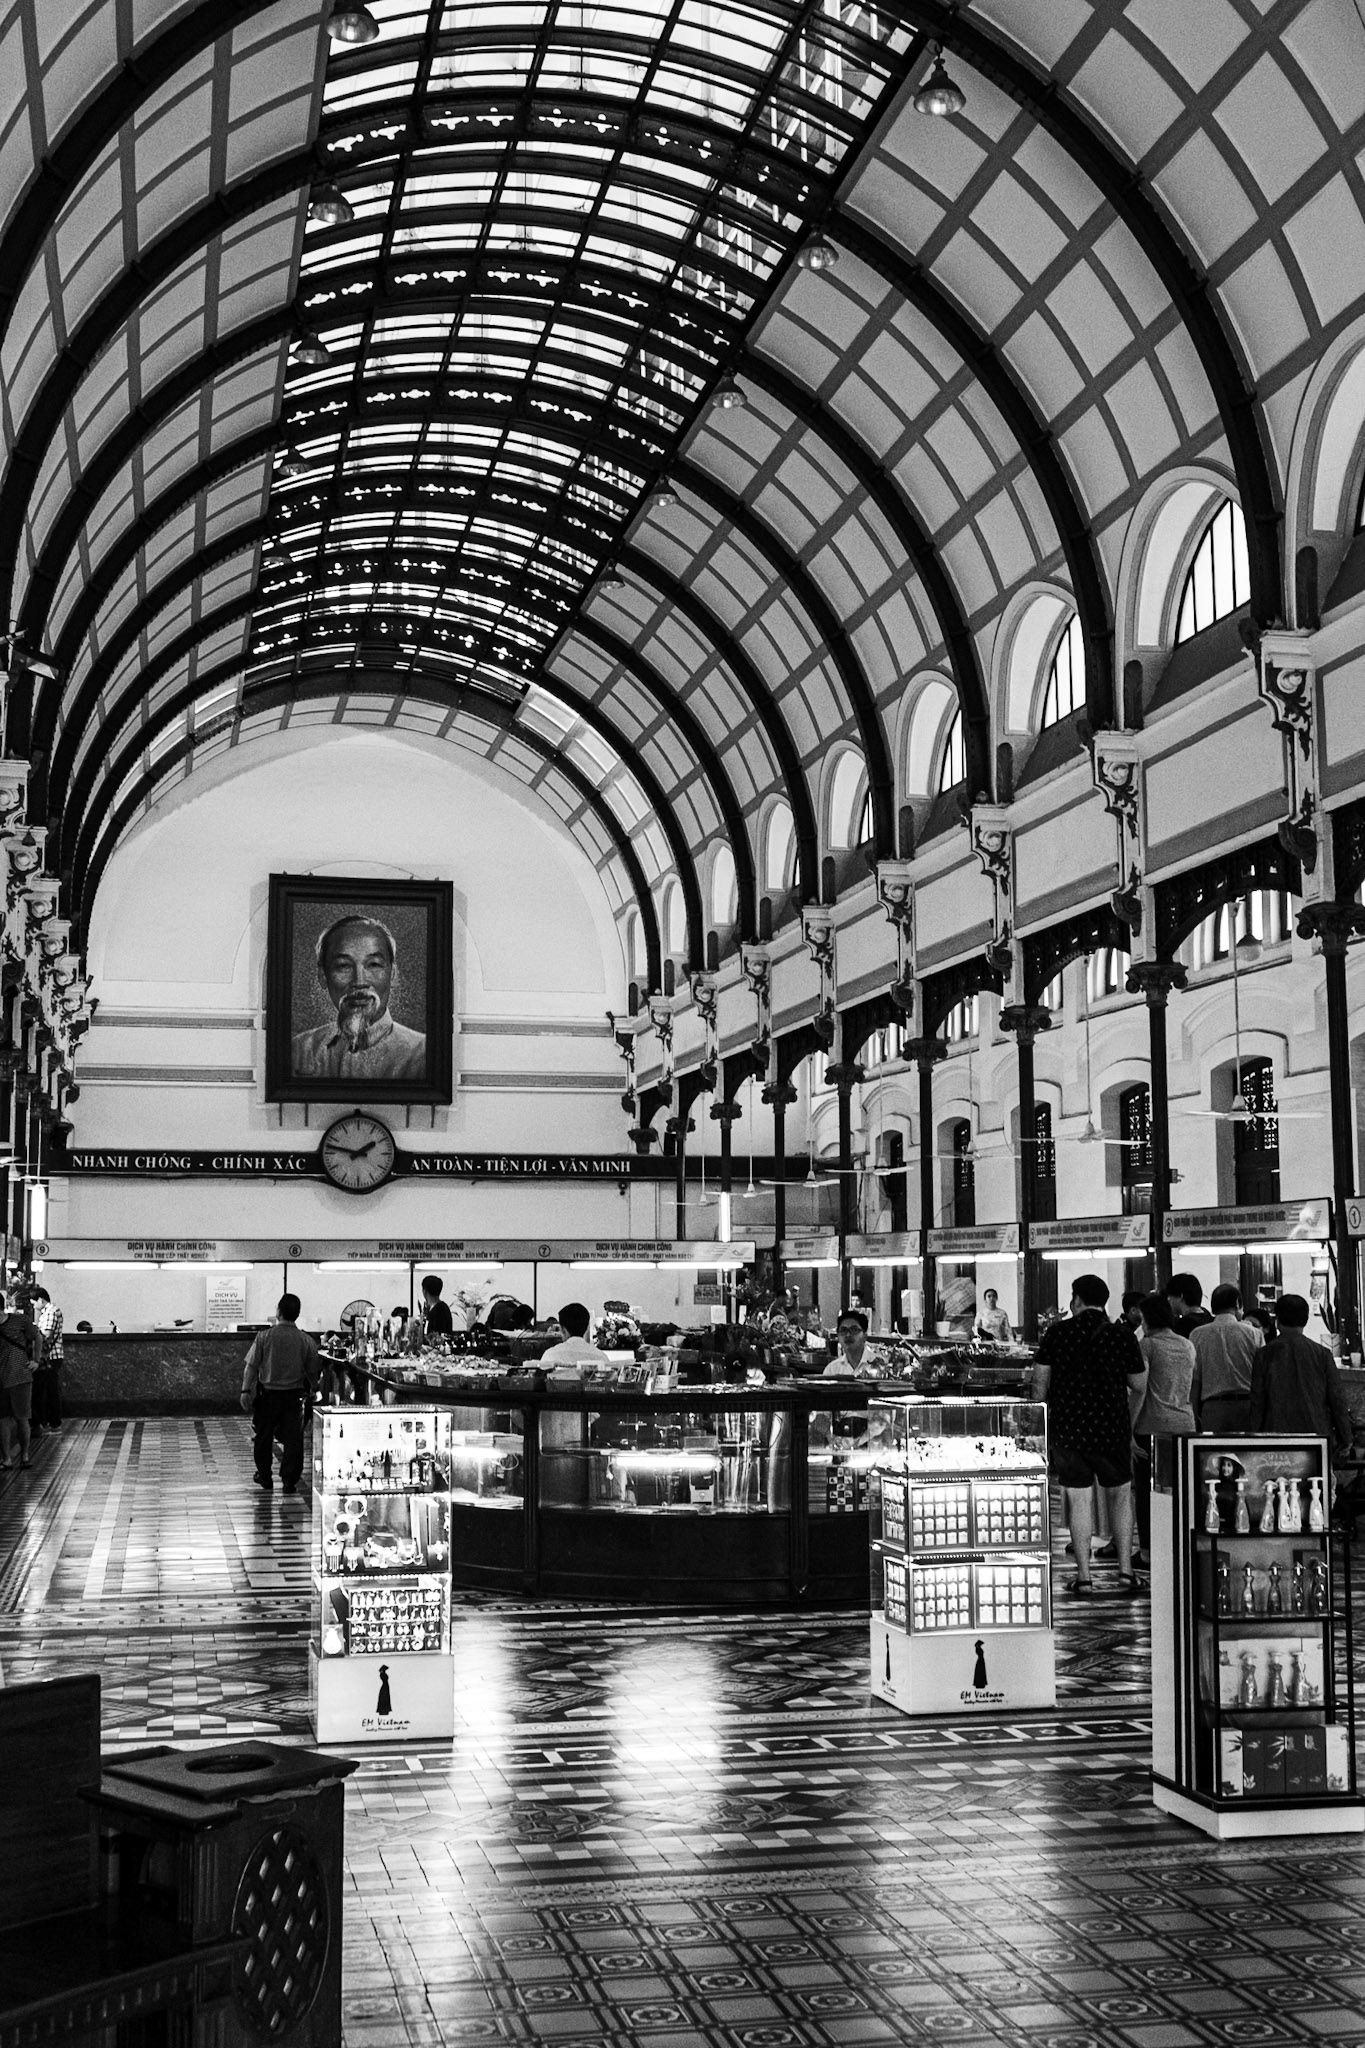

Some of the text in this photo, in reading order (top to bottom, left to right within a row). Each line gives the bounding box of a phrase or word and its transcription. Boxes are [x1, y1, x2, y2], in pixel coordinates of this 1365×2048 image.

[72, 1155, 129, 1168] NHANH
[134, 1152, 191, 1169] CHÓNG
[212, 1154, 265, 1169] CHÍNH
[273, 1154, 306, 1170] XÁC
[411, 1159, 430, 1171] AN
[433, 1156, 473, 1171] TOÀN
[485, 1157, 519, 1174] TIỆN
[523, 1158, 547, 1175] LỢI
[559, 1158, 589, 1172] VĂN
[592, 1161, 631, 1173] MINH
[127, 1242, 144, 1251] DỊCH
[145, 1242, 155, 1251] VỤ
[156, 1241, 175, 1250] HÀNH
[176, 1241, 197, 1250] CHÍNH
[378, 1242, 394, 1251] DỊCH
[406, 1241, 424, 1250] HÀNH
[425, 1241, 446, 1250] CHÍNH
[446, 1241, 464, 1250] CÔNG
[361, 1717, 411, 1727] EM Vietnam
